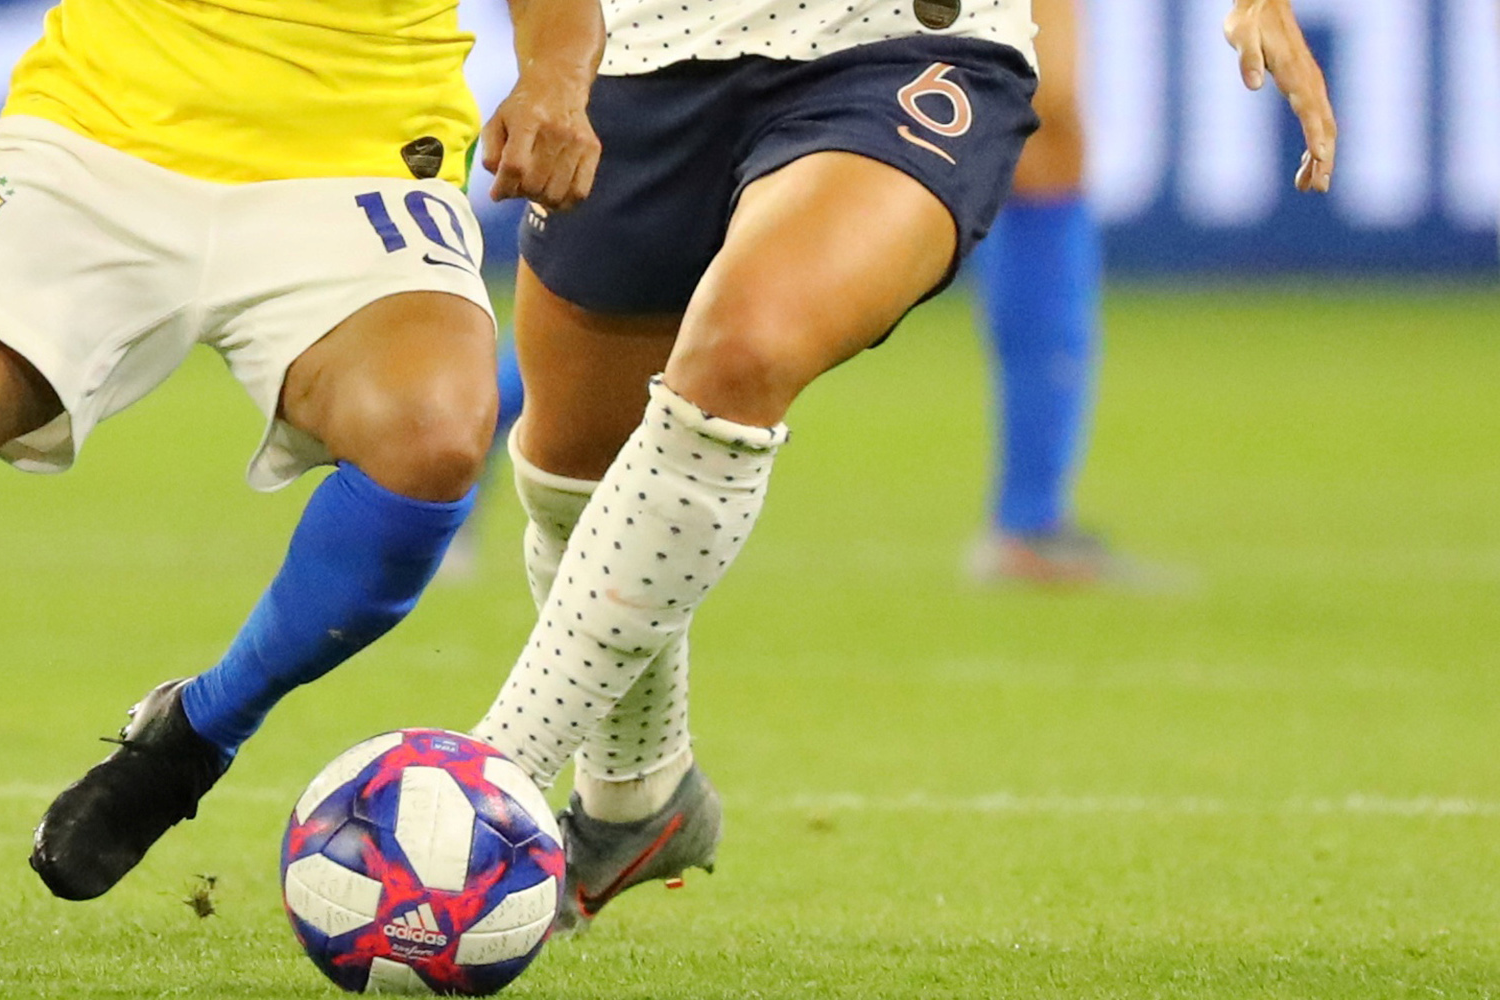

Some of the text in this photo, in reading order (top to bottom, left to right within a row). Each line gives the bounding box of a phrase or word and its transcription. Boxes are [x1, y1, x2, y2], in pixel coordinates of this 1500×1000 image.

[897, 61, 973, 138] 6
[354, 189, 478, 270] 10
[383, 924, 448, 947] adidas
